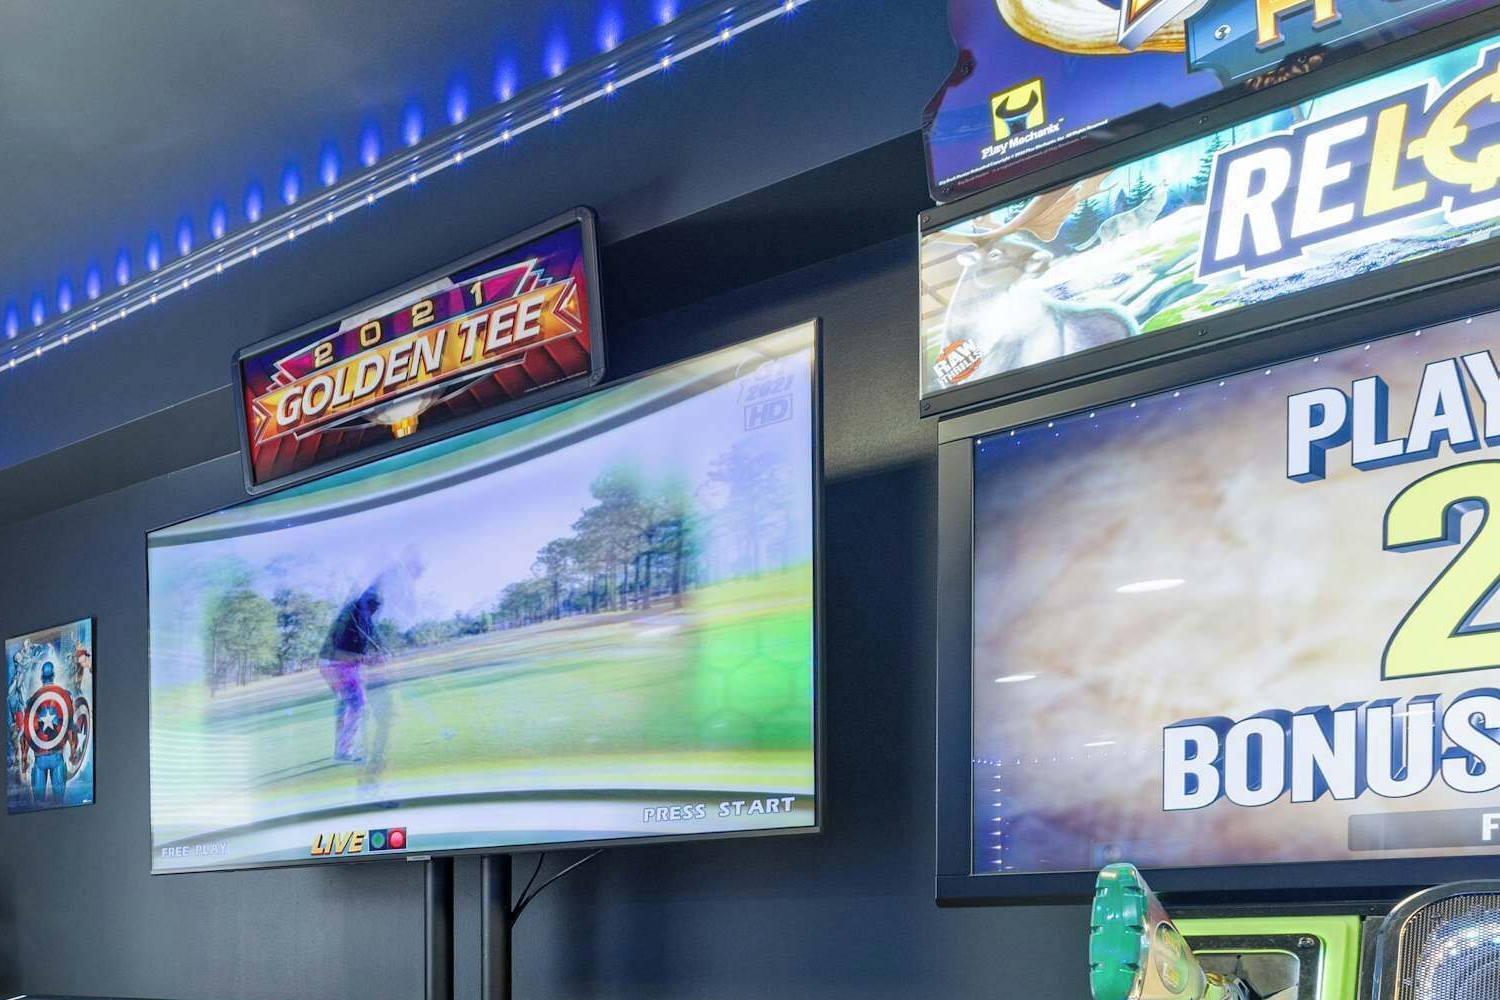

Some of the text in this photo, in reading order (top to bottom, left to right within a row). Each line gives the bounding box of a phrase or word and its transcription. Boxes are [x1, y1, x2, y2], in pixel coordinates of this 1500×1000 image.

[981, 142, 1008, 160] Play
[1009, 121, 1061, 149] Mechanix
[313, 281, 484, 368] 2021
[276, 294, 545, 427] GOLDEN TEE
[932, 338, 978, 378] RAW
[748, 398, 789, 427] HD
[1287, 350, 1500, 484] PLAY
[1162, 688, 1500, 811] BONUS
[643, 797, 795, 822] PRESS START
[161, 841, 228, 858] FREE PLAY
[310, 830, 366, 856] LIVE
